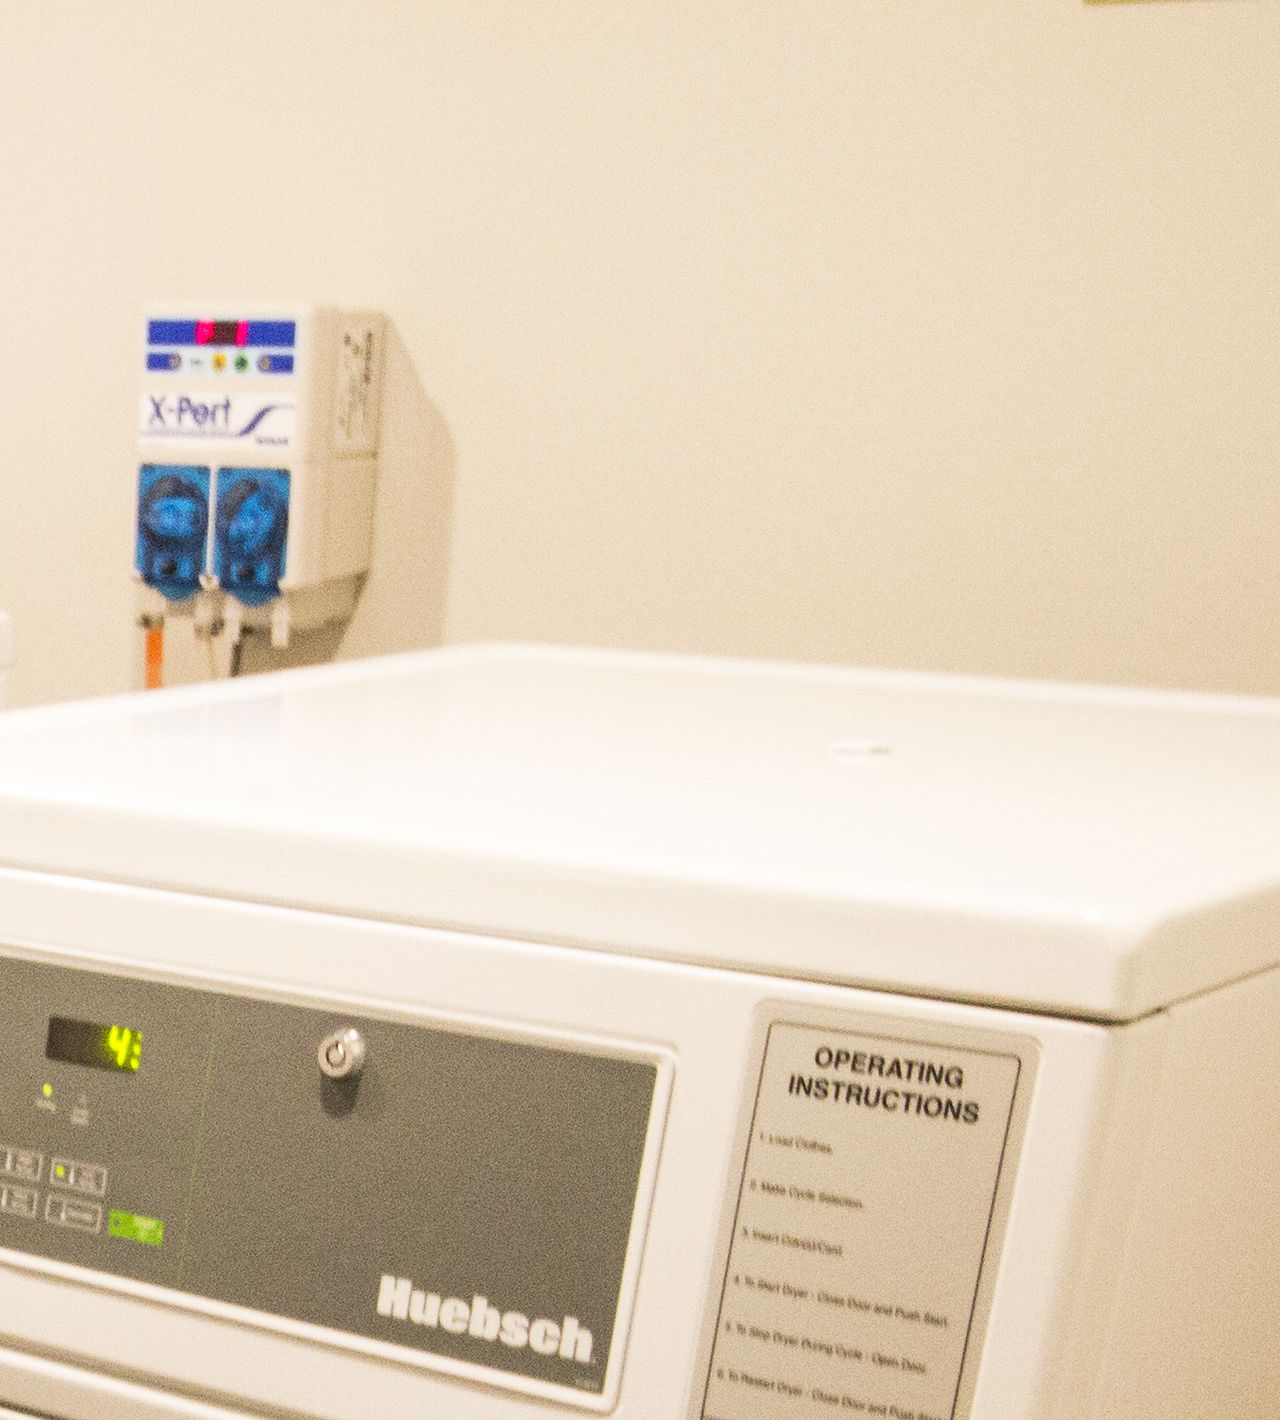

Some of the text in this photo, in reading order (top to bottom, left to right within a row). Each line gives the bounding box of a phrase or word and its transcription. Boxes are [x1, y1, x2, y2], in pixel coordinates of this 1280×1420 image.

[815, 1046, 964, 1089] OPERATING
[788, 1073, 980, 1124] INSTRUCTIONS
[376, 1274, 593, 1363] Huebsch
[782, 1282, 809, 1299] Dryer
[873, 1303, 892, 1316] and
[894, 1306, 921, 1323] Push
[772, 1329, 799, 1347] Dryer
[835, 1344, 863, 1361] Cycle
[871, 1351, 899, 1369] Open
[776, 1380, 802, 1398] Dryer
[867, 1401, 887, 1415] and
